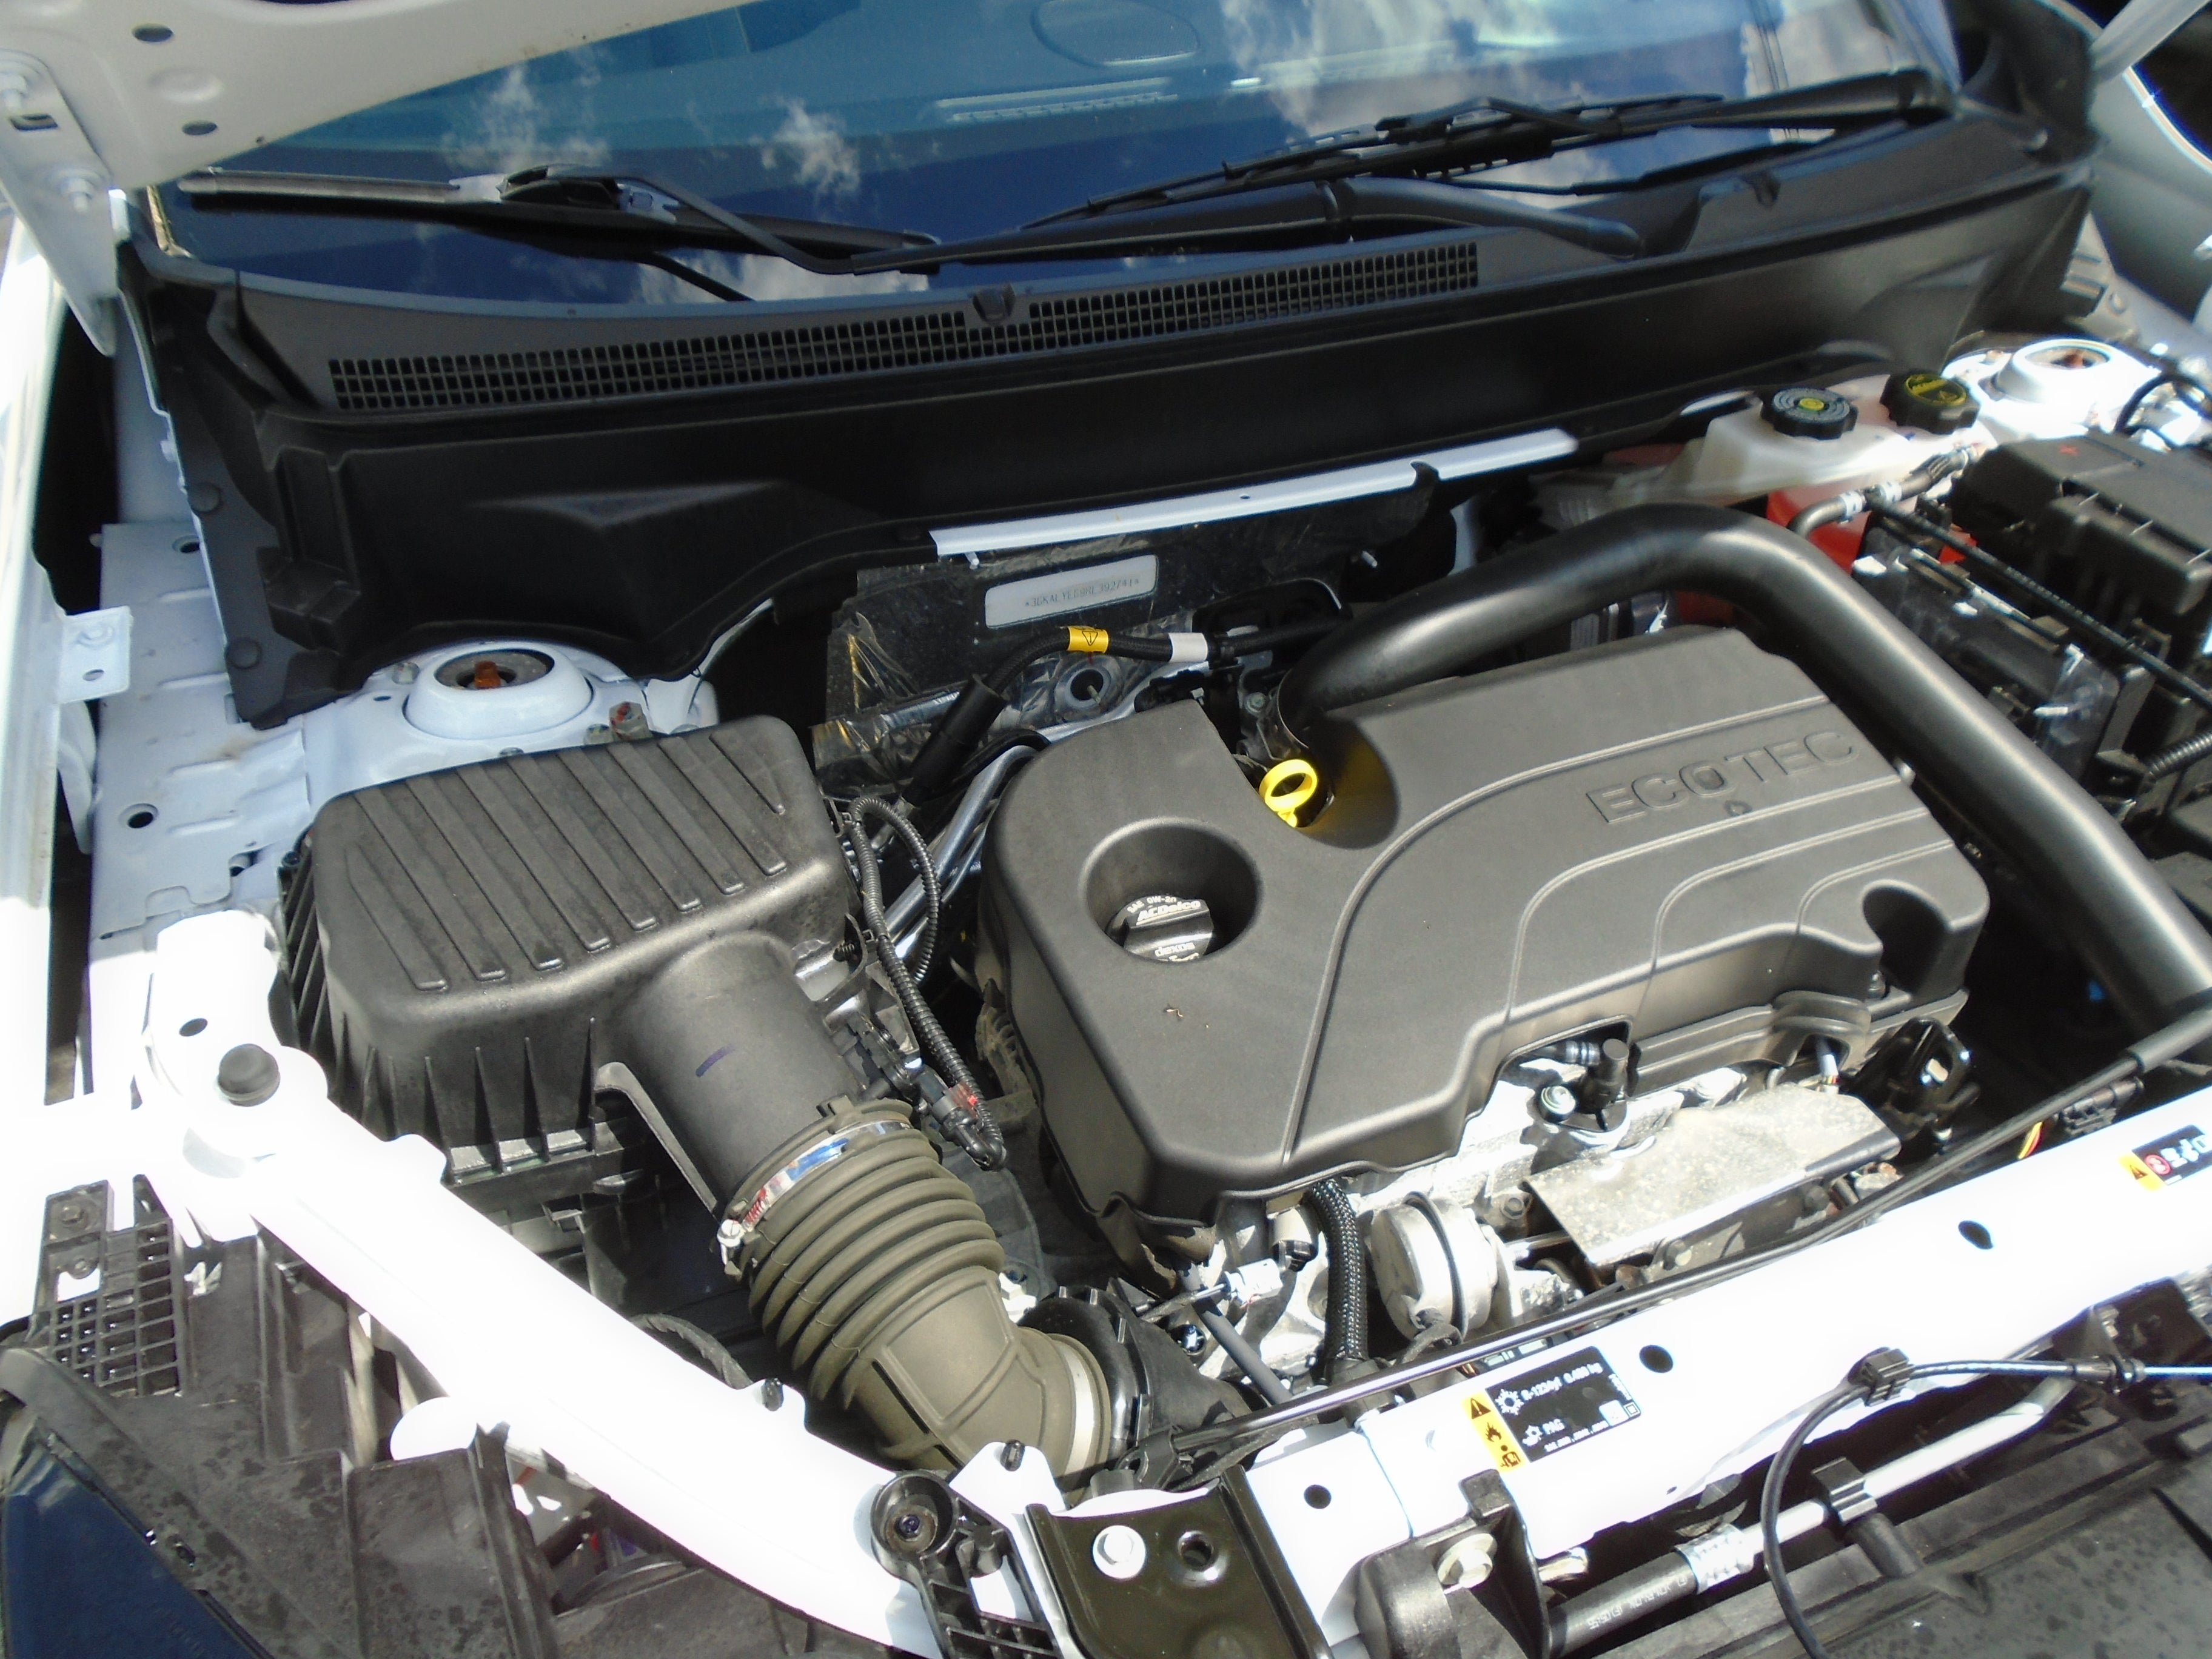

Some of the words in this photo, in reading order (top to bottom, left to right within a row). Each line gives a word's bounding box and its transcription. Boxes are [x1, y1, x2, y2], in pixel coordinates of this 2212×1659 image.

[1585, 732, 1860, 824] ECOTEC
[1127, 900, 1145, 913] SAE
[1137, 900, 1201, 922] ACDelco
[1155, 942, 1195, 957] dexos
[1542, 1418, 1566, 1435] PAG
